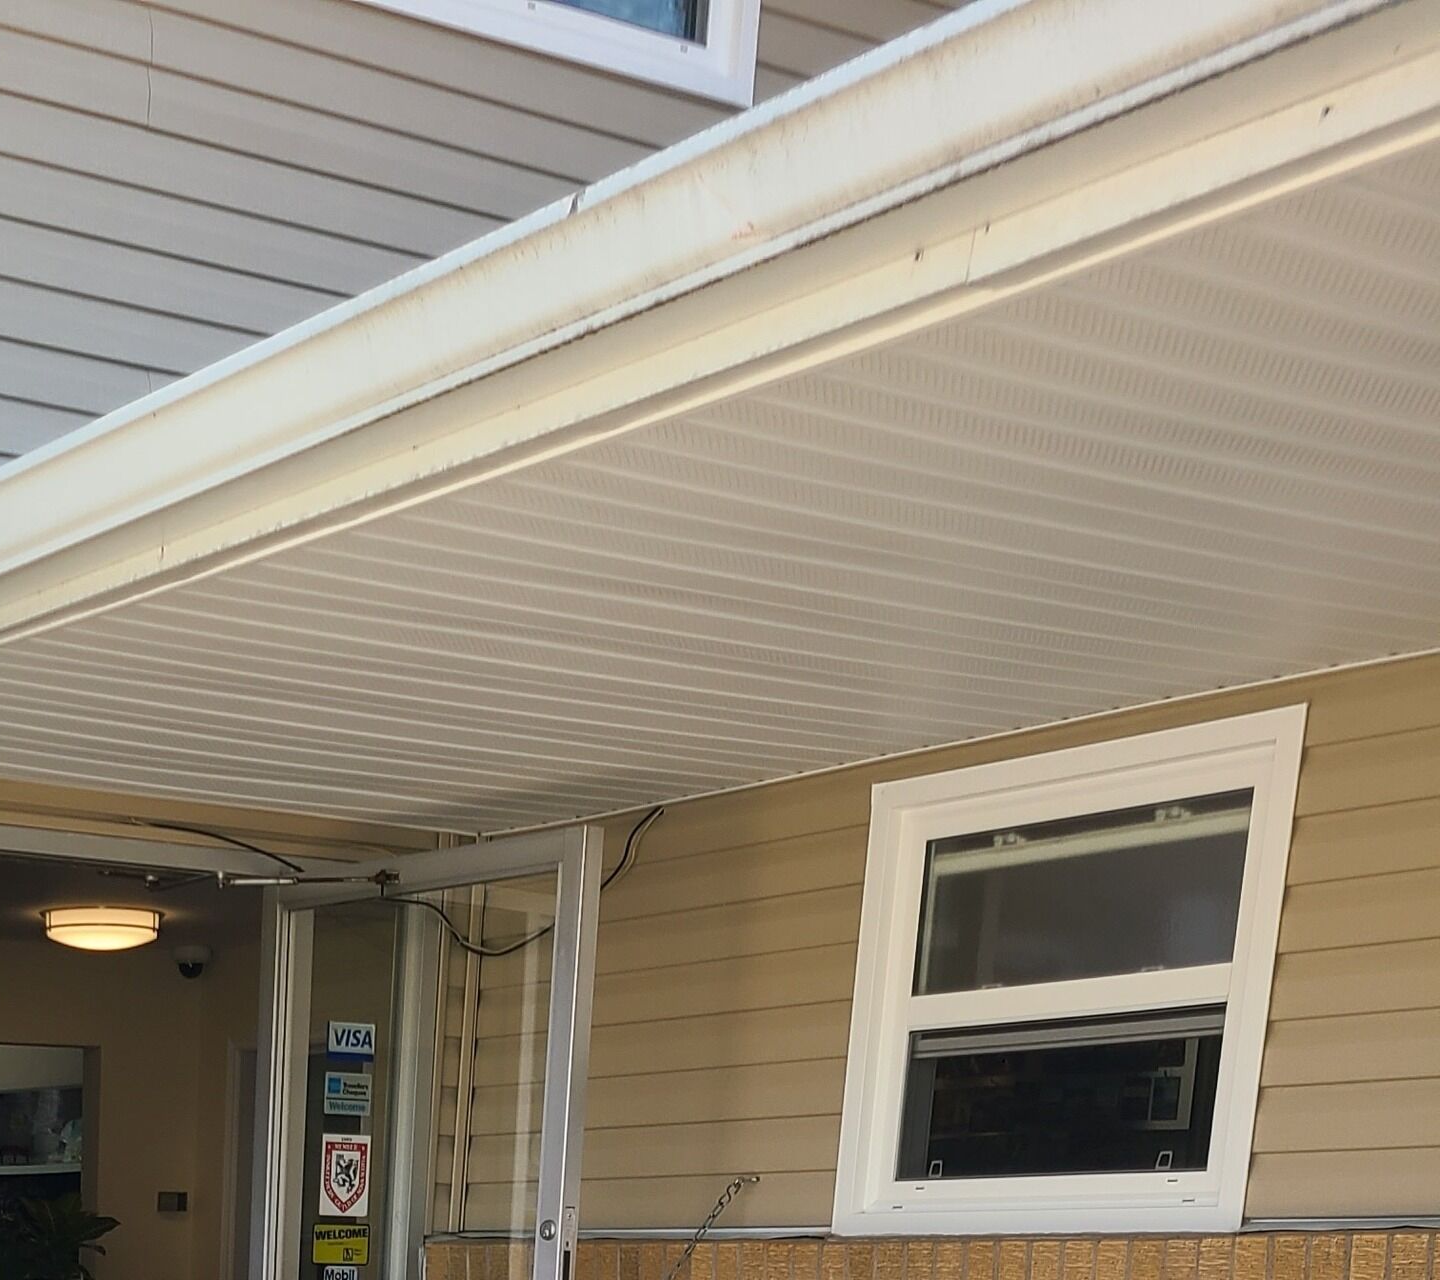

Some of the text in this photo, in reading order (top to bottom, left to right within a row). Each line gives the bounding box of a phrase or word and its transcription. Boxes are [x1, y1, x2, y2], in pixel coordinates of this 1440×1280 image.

[334, 1028, 373, 1049] VISA
[329, 1101, 366, 1112] Welcome
[315, 1228, 368, 1240] WELCOME
